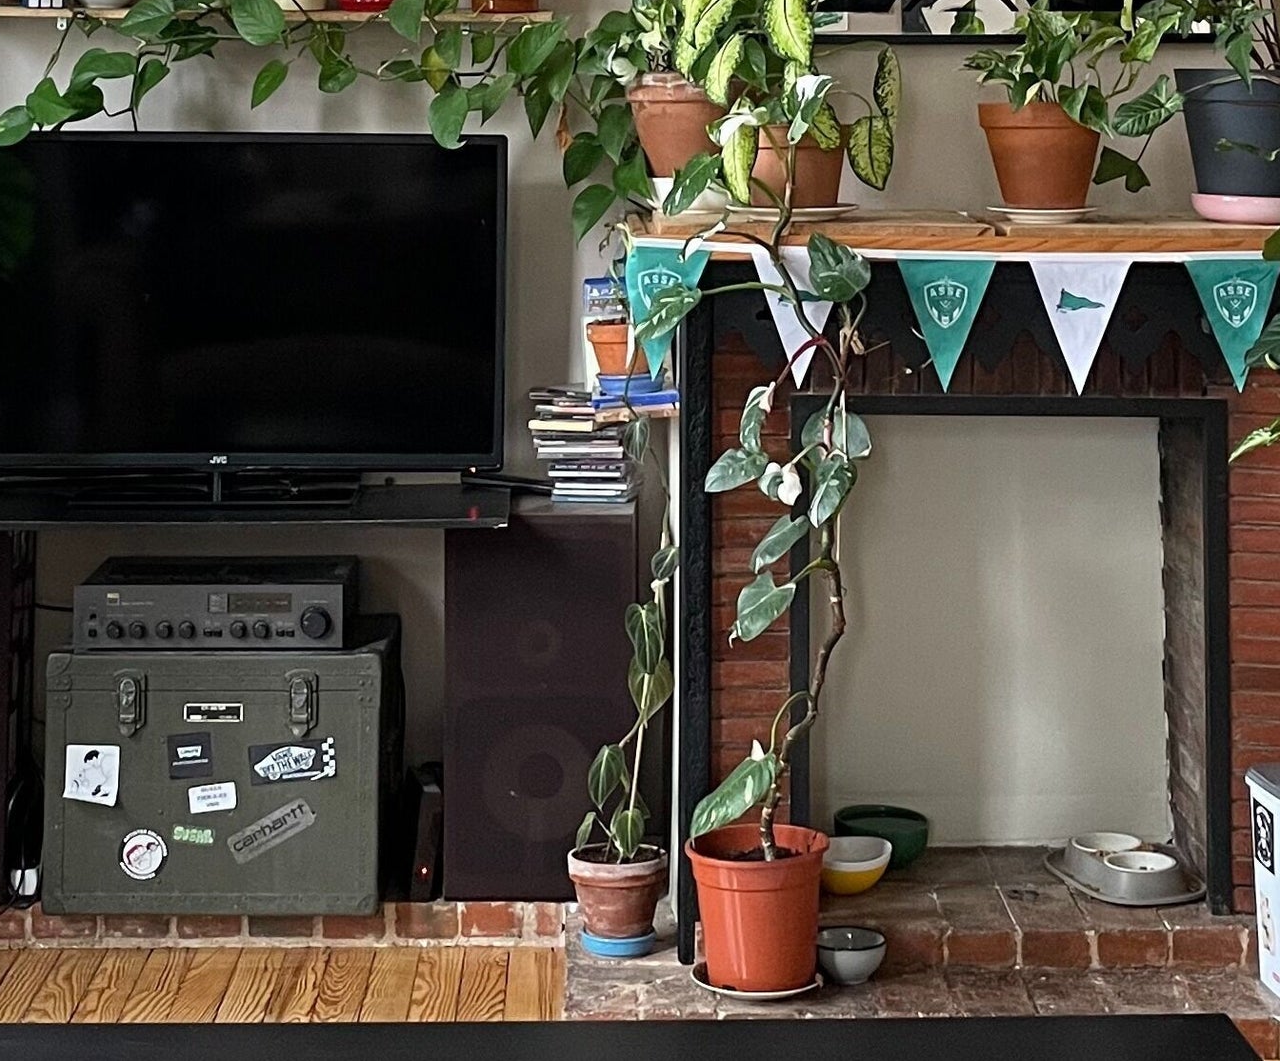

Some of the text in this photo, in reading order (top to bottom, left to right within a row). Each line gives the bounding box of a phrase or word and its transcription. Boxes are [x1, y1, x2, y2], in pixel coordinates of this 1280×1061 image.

[929, 286, 964, 298] ASSE
[1219, 285, 1253, 298] ASSE
[233, 804, 305, 852] carhartt
